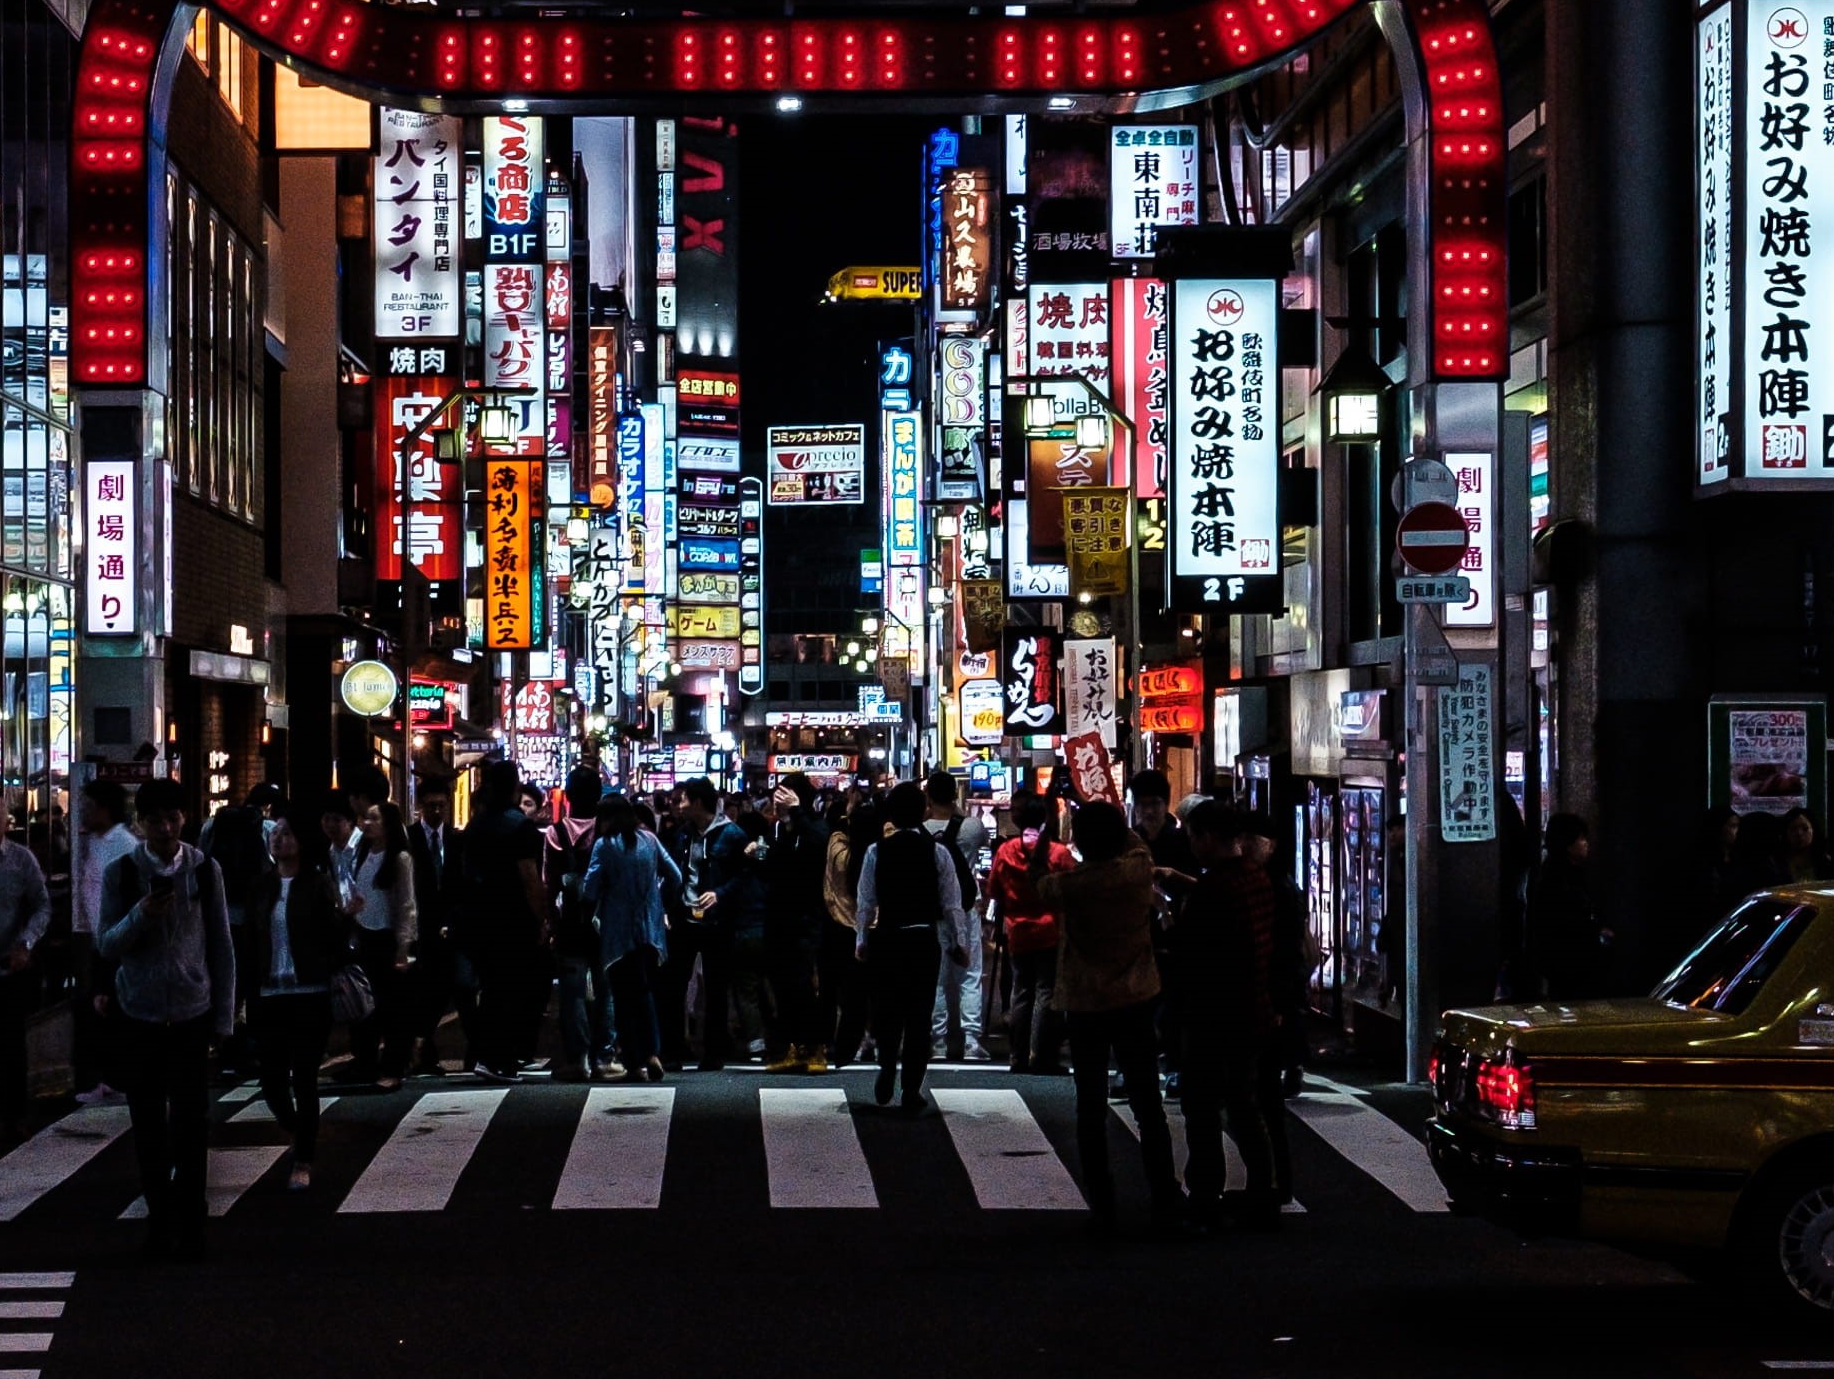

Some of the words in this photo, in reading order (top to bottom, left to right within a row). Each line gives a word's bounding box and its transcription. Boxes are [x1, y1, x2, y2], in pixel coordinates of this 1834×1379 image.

[385, 139, 426, 282] バンタイ
[434, 140, 451, 272] タイ国料理専門店
[490, 234, 537, 255] B1F
[1758, 51, 1812, 420] お好み焼き本陣
[389, 348, 447, 374] 焼肉
[402, 316, 432, 332] 3F
[1190, 327, 1236, 558] お好み焼本陣
[97, 474, 124, 619] 劇場通り
[1202, 577, 1245, 601] 2F
